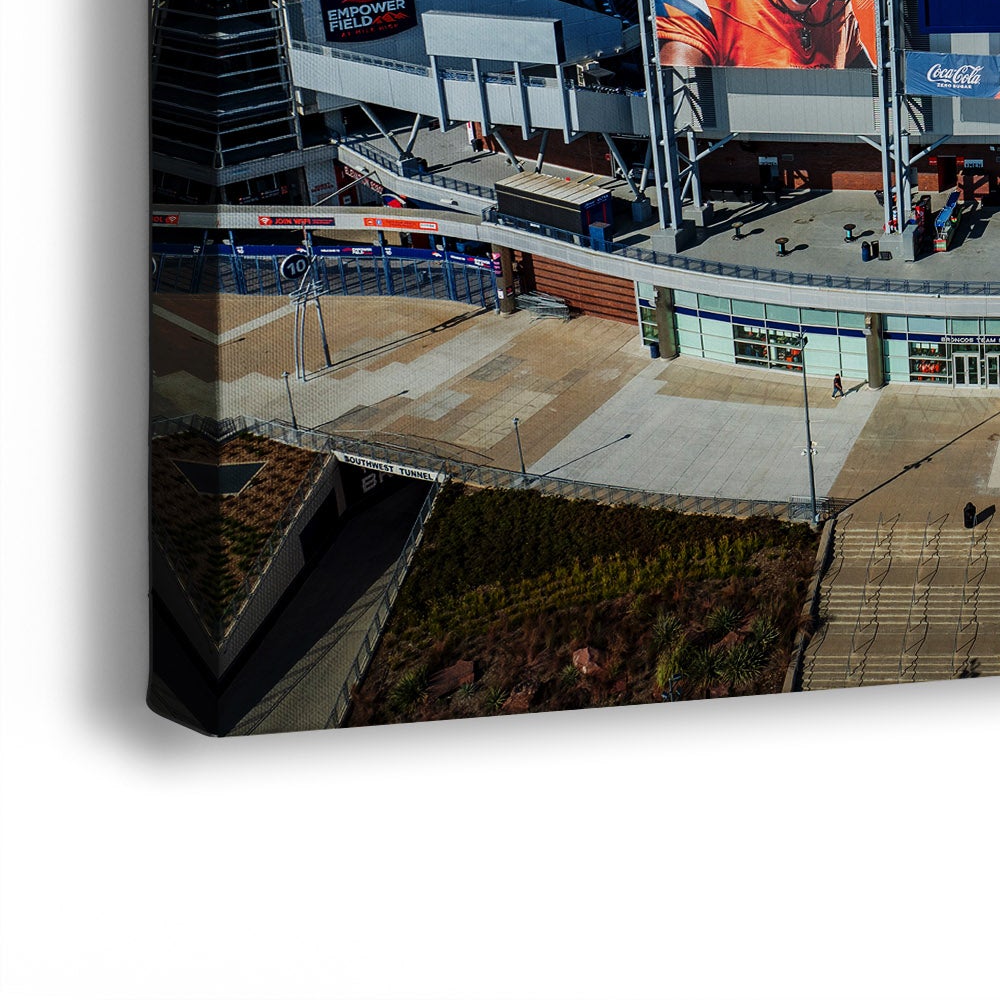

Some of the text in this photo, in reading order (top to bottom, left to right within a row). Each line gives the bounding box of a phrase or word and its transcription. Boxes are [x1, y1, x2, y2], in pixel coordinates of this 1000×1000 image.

[327, 0, 405, 21] EMPOWER
[329, 15, 372, 32] FIELD
[927, 63, 984, 84] Coca-Cola
[286, 260, 306, 274] 10
[344, 455, 394, 473] SOUTHWEST
[398, 467, 434, 481] TUNNEL
